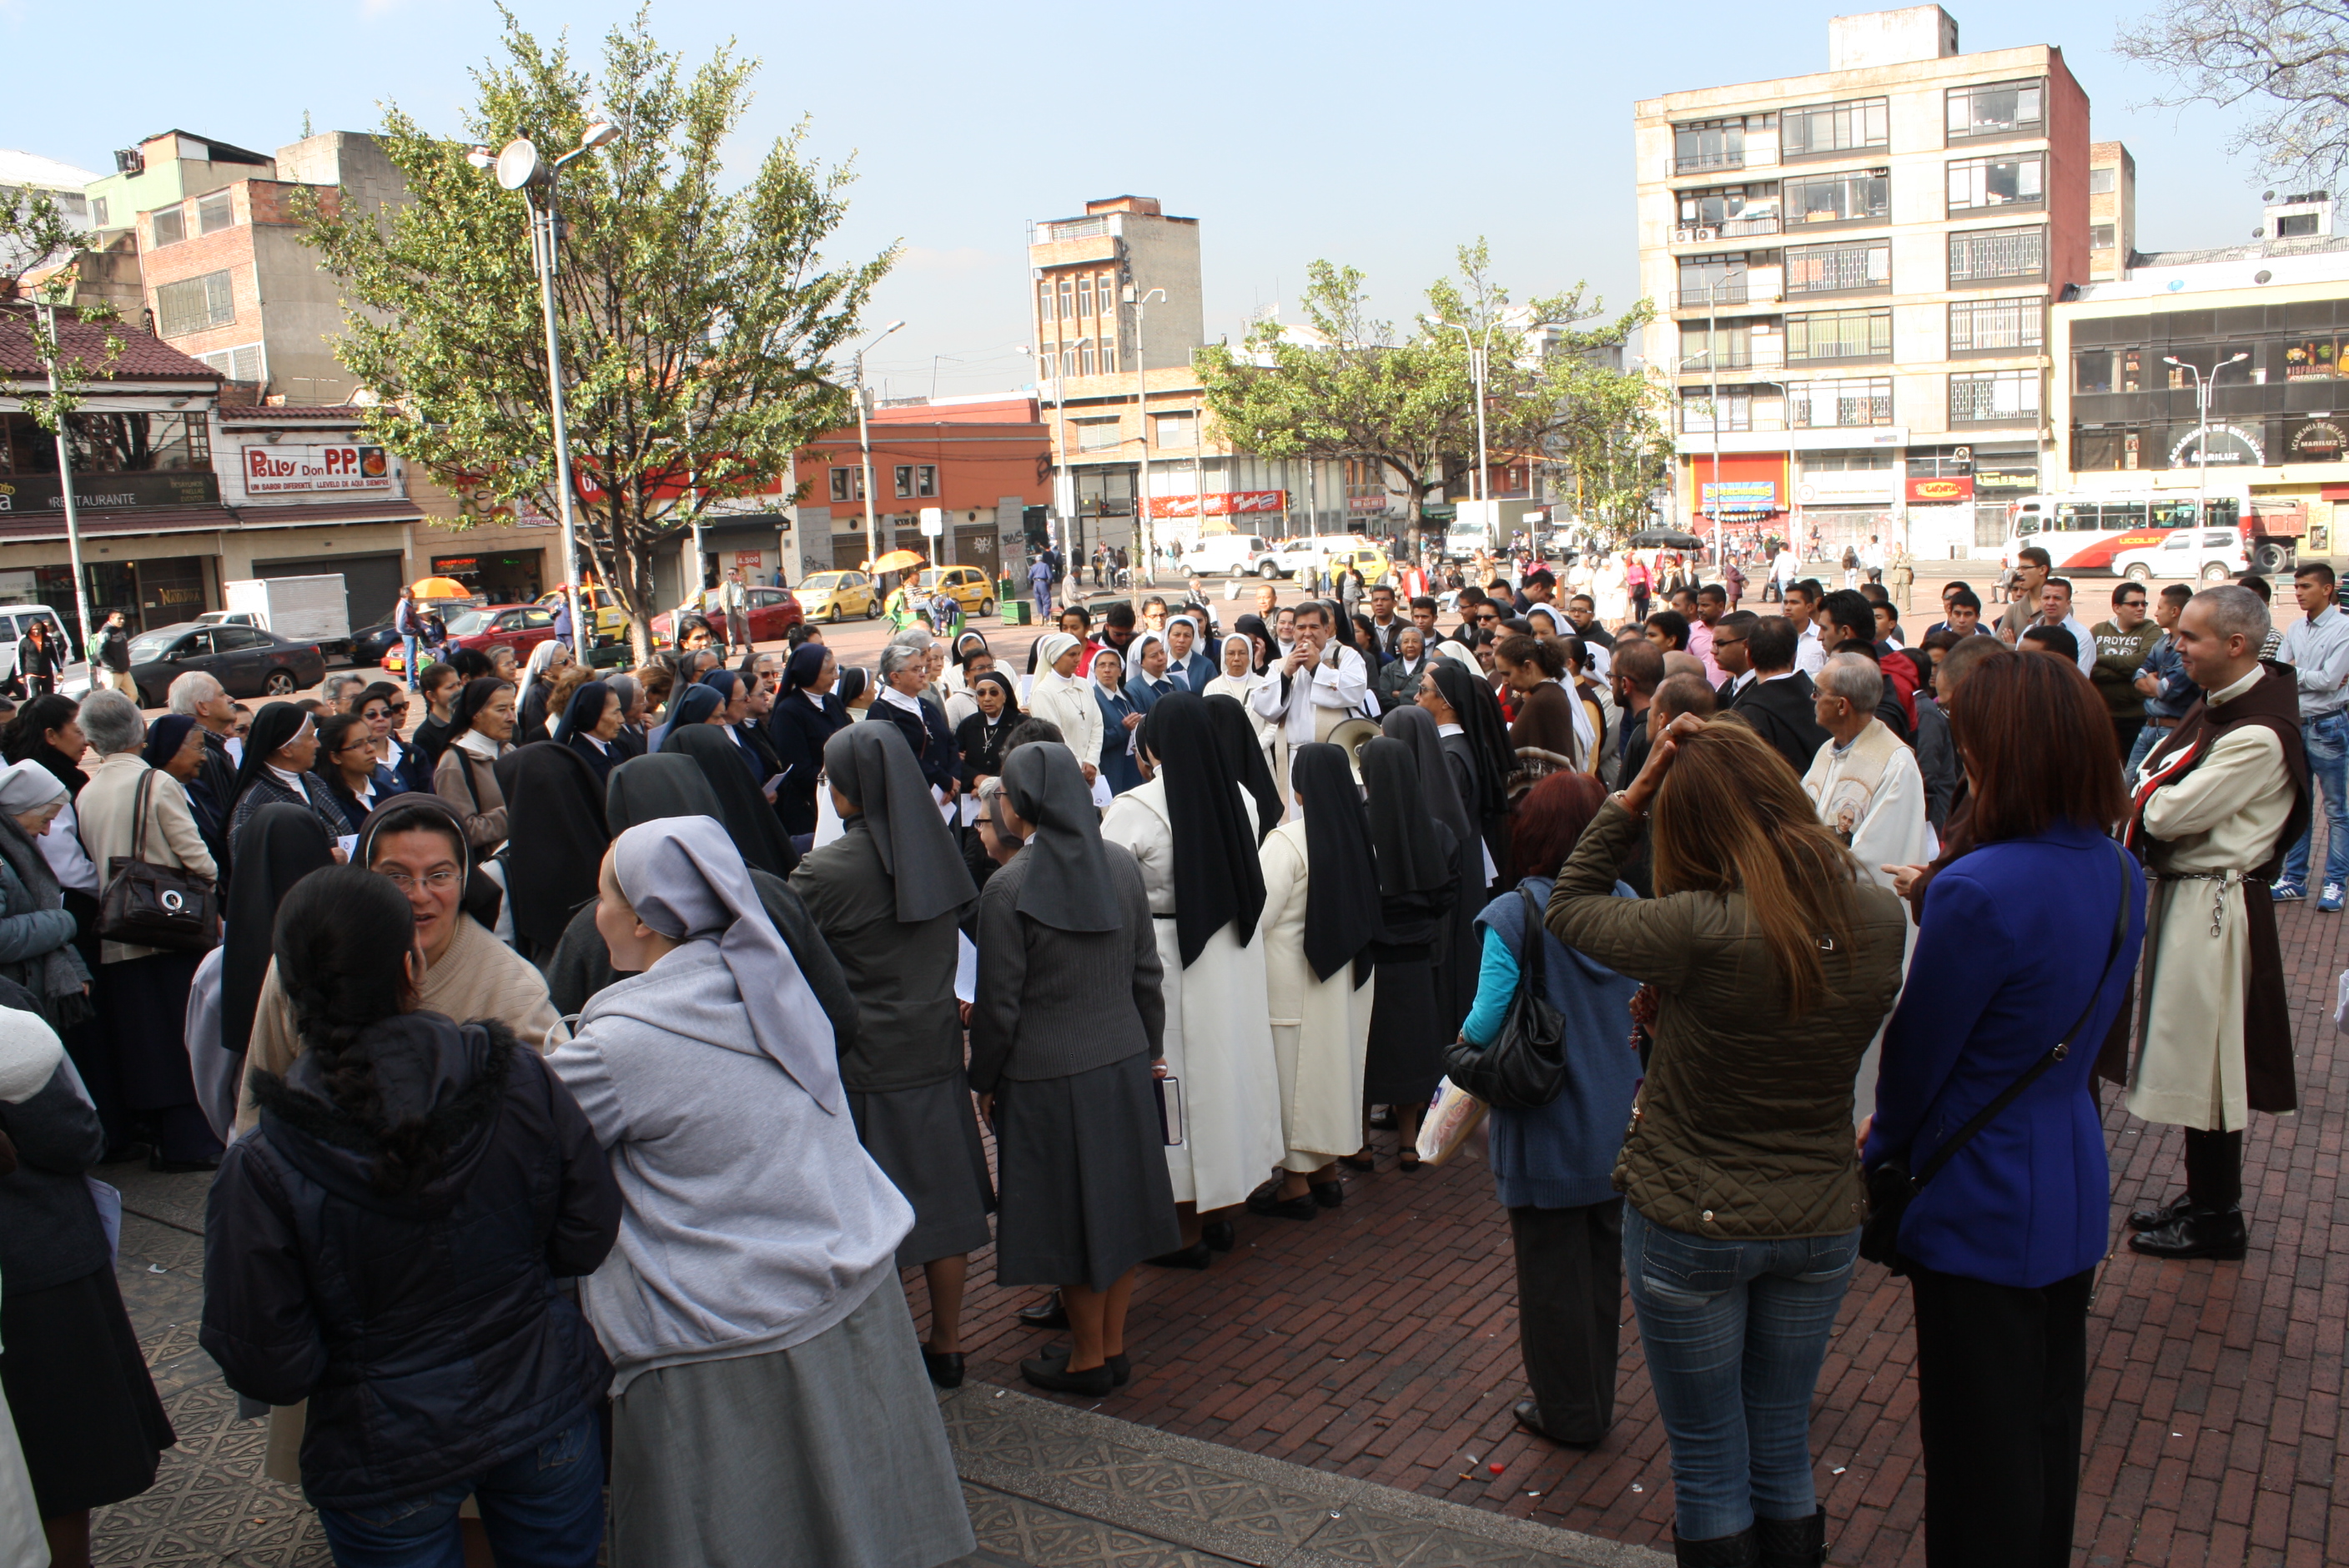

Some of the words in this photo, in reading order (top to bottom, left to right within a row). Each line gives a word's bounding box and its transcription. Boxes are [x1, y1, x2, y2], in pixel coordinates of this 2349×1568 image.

[2212, 424, 2226, 432] DE
[2227, 425, 2263, 459] BELLEZA
[302, 465, 324, 476] Don
[324, 449, 358, 475] P.P.
[737, 555, 759, 565] 4.500
